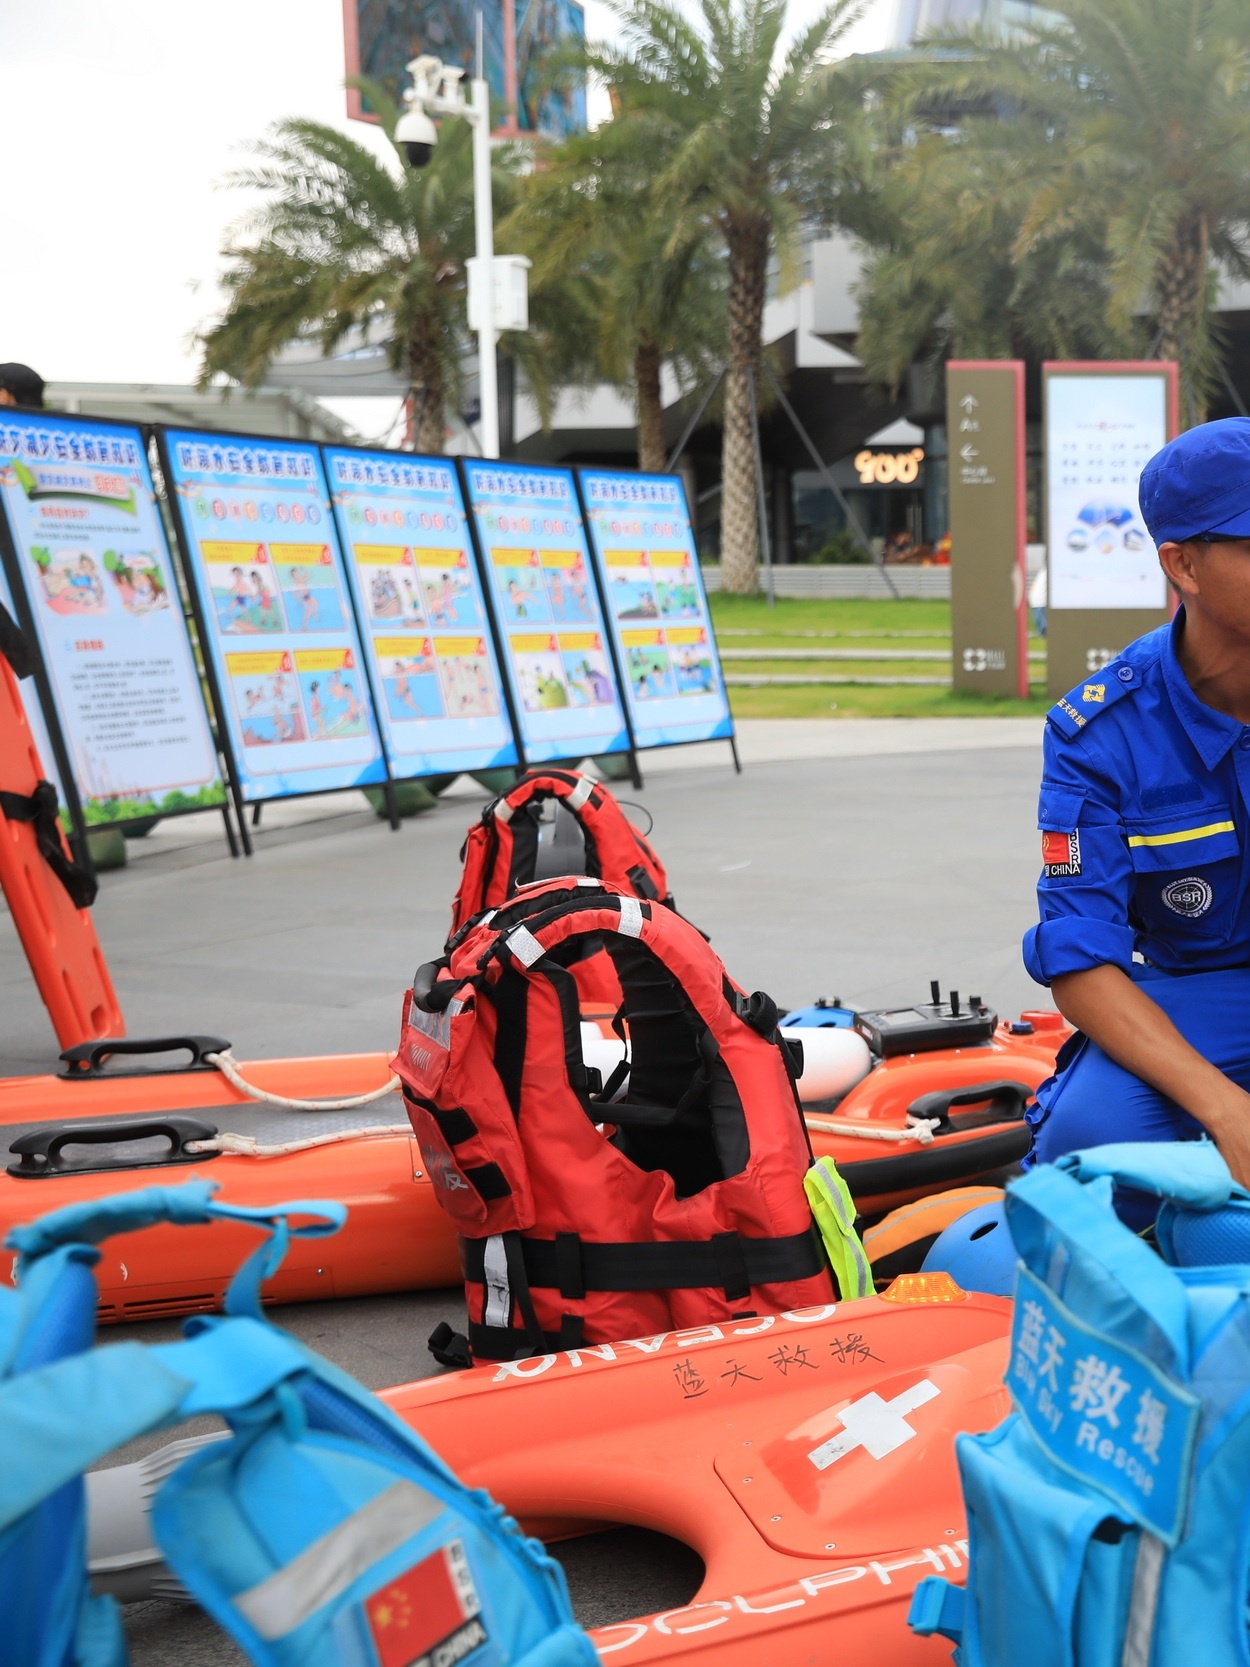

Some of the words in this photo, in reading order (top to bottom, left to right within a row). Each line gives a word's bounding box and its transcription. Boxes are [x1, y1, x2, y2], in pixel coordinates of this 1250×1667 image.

[1051, 863, 1081, 876] CHINA
[1070, 831, 1080, 864] BSR
[1172, 891, 1202, 904] BSR
[672, 1332, 886, 1400] 蓝天救援
[1017, 1302, 1167, 1466] 蓝天救援
[1075, 1421, 1155, 1497] Rescue
[596, 1538, 969, 1656] DOLPHI
